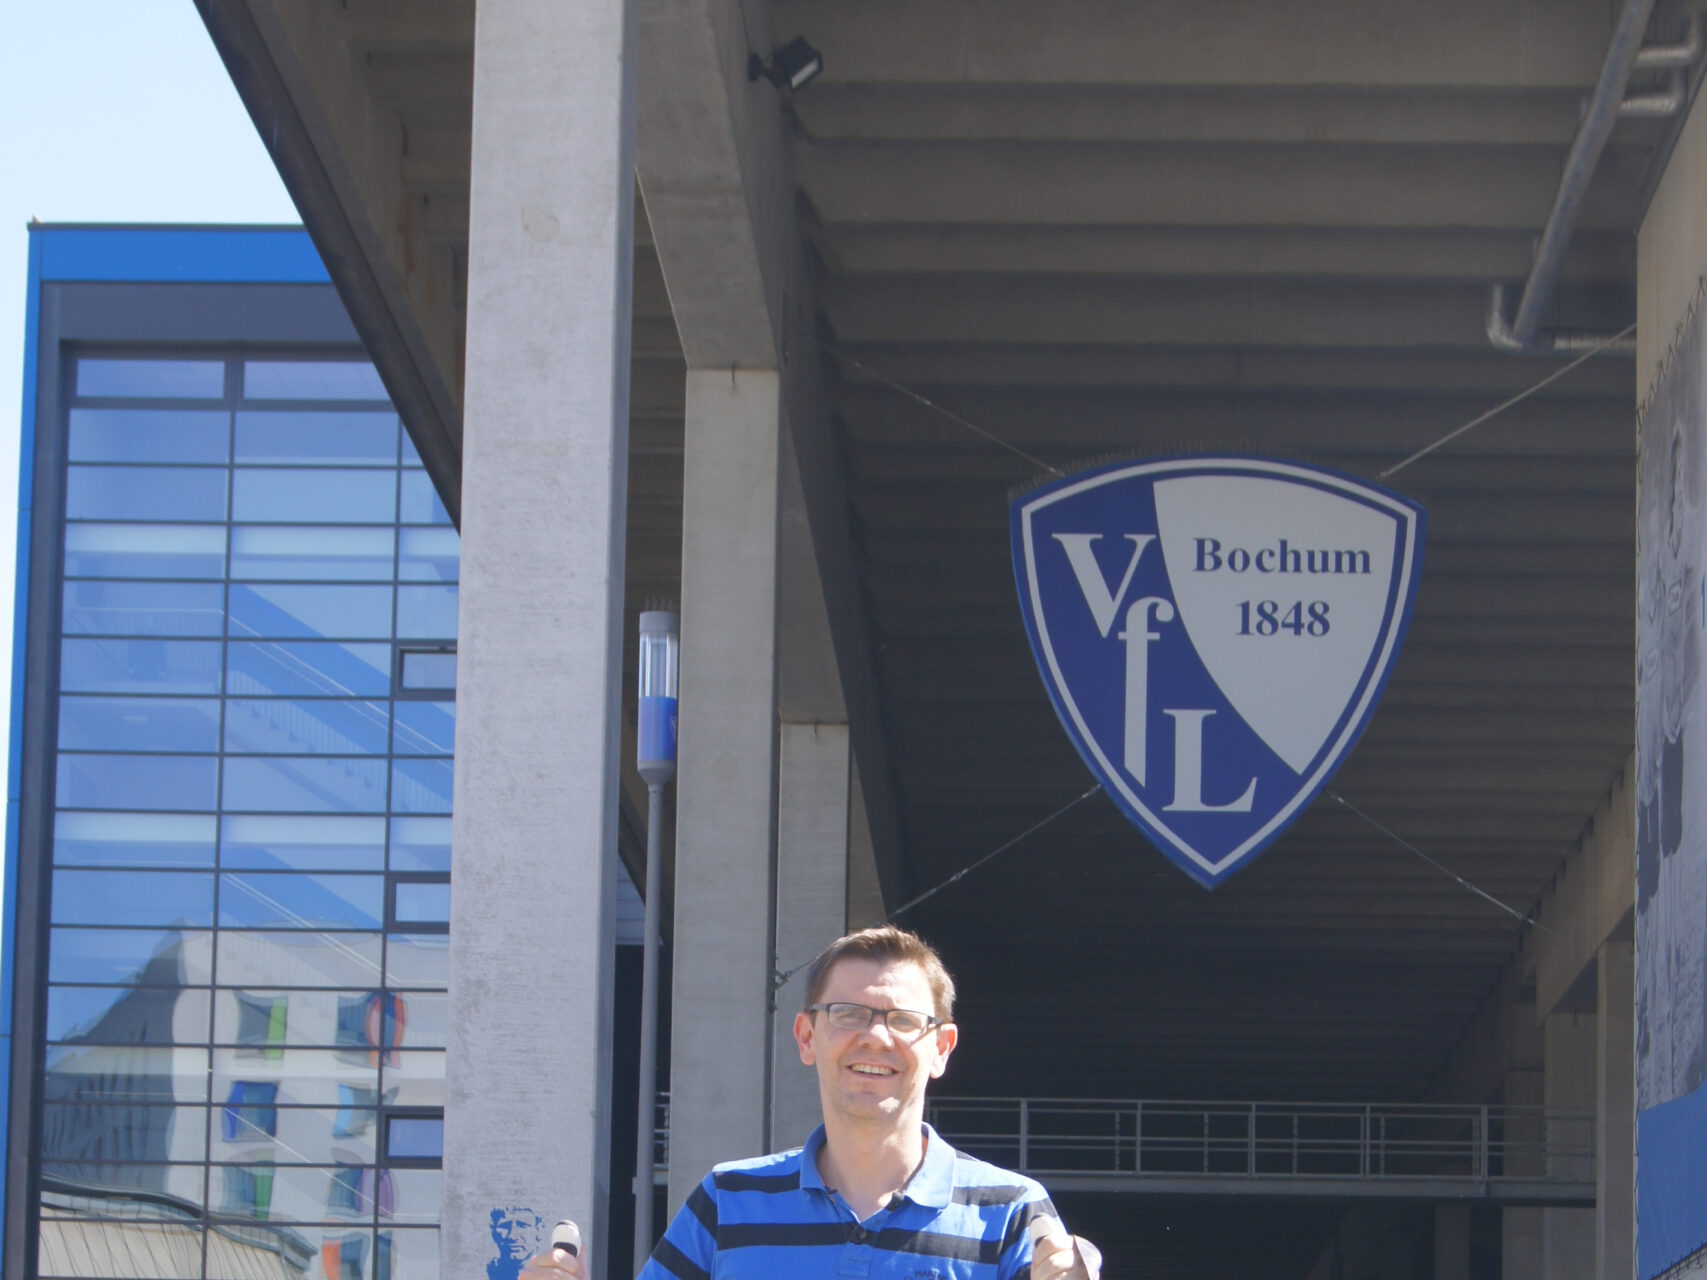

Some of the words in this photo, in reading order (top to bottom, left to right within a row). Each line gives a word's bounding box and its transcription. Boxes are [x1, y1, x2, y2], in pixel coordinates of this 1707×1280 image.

[1192, 537, 1372, 574] Bochum
[1234, 600, 1331, 637] 1848
[1051, 533, 1258, 813] VfL
